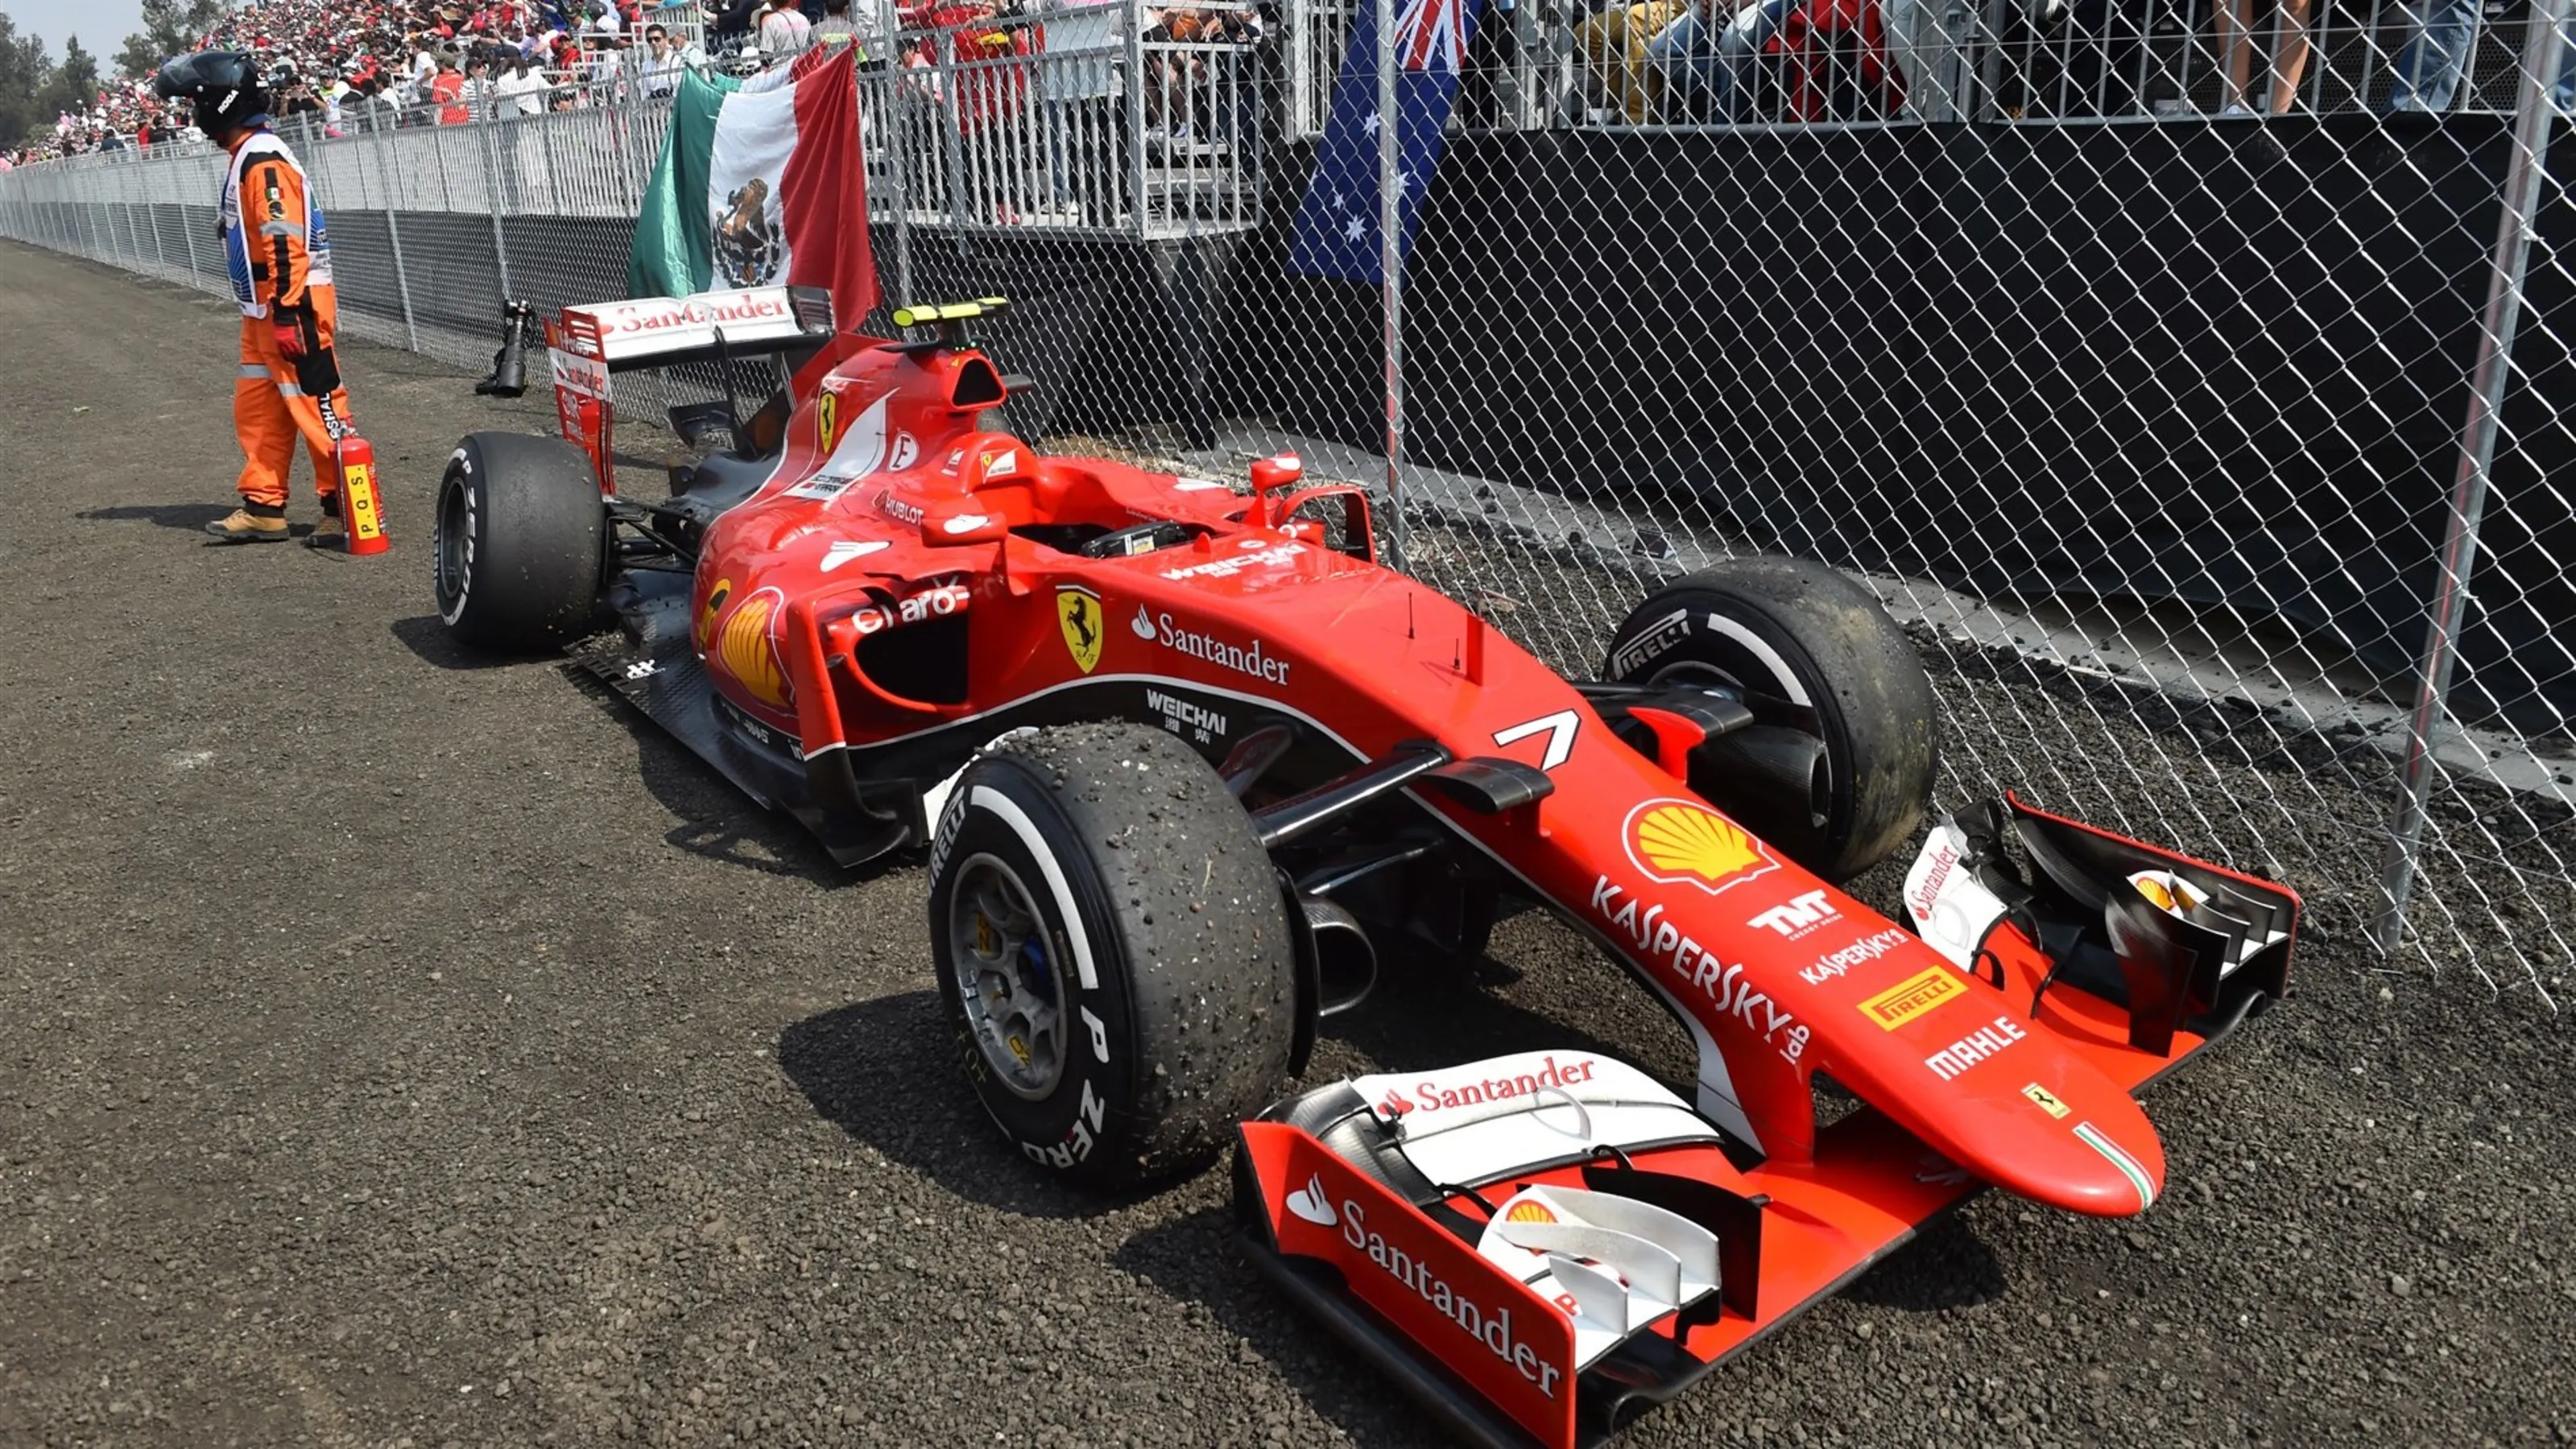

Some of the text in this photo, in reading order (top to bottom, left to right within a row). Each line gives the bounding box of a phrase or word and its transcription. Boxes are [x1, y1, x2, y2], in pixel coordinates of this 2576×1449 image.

[217, 89, 239, 114] RODA
[617, 295, 786, 332] Santander
[892, 436, 911, 469] E
[884, 497, 924, 526] HUBLOT
[852, 586, 966, 634] Claro
[1159, 613, 1289, 686] Santander
[1614, 608, 1693, 682] PIRELLI
[1147, 688, 1226, 736] WEICHAI
[1493, 708, 1582, 770] 7
[928, 785, 965, 900] PIRELLI
[1912, 845, 1958, 911] Santander
[1746, 889, 1837, 936] TNT
[1591, 874, 1810, 1065] KASPERSKY lab
[1798, 930, 1899, 985] KASPERSKY
[1871, 974, 1954, 1022] PIRELLI
[1924, 1016, 2028, 1082] MAHLE
[1022, 1005, 1110, 1169] P ZERO
[1416, 1056, 1595, 1112] Santander
[1342, 1199, 1560, 1398] Santander
